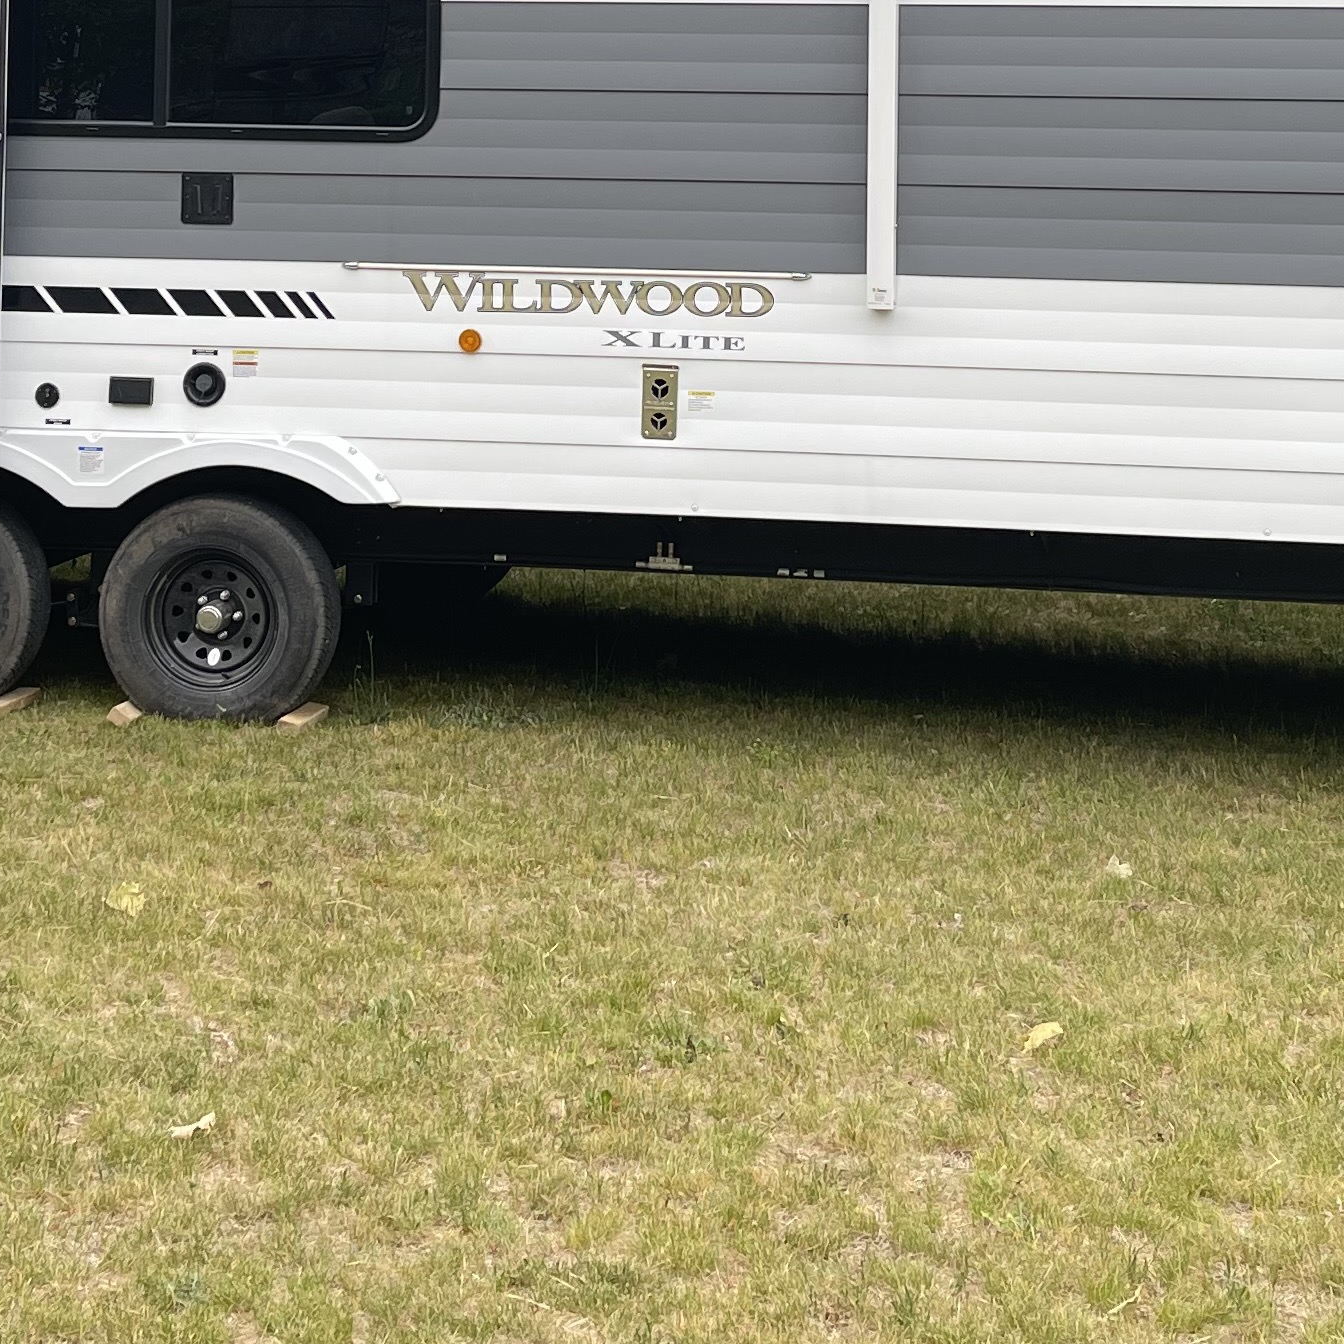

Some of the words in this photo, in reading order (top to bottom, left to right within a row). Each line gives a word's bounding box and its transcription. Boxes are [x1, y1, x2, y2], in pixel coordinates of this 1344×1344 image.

[402, 269, 774, 317] WILDWOOD
[601, 329, 643, 348] X
[648, 331, 746, 351] LITE
